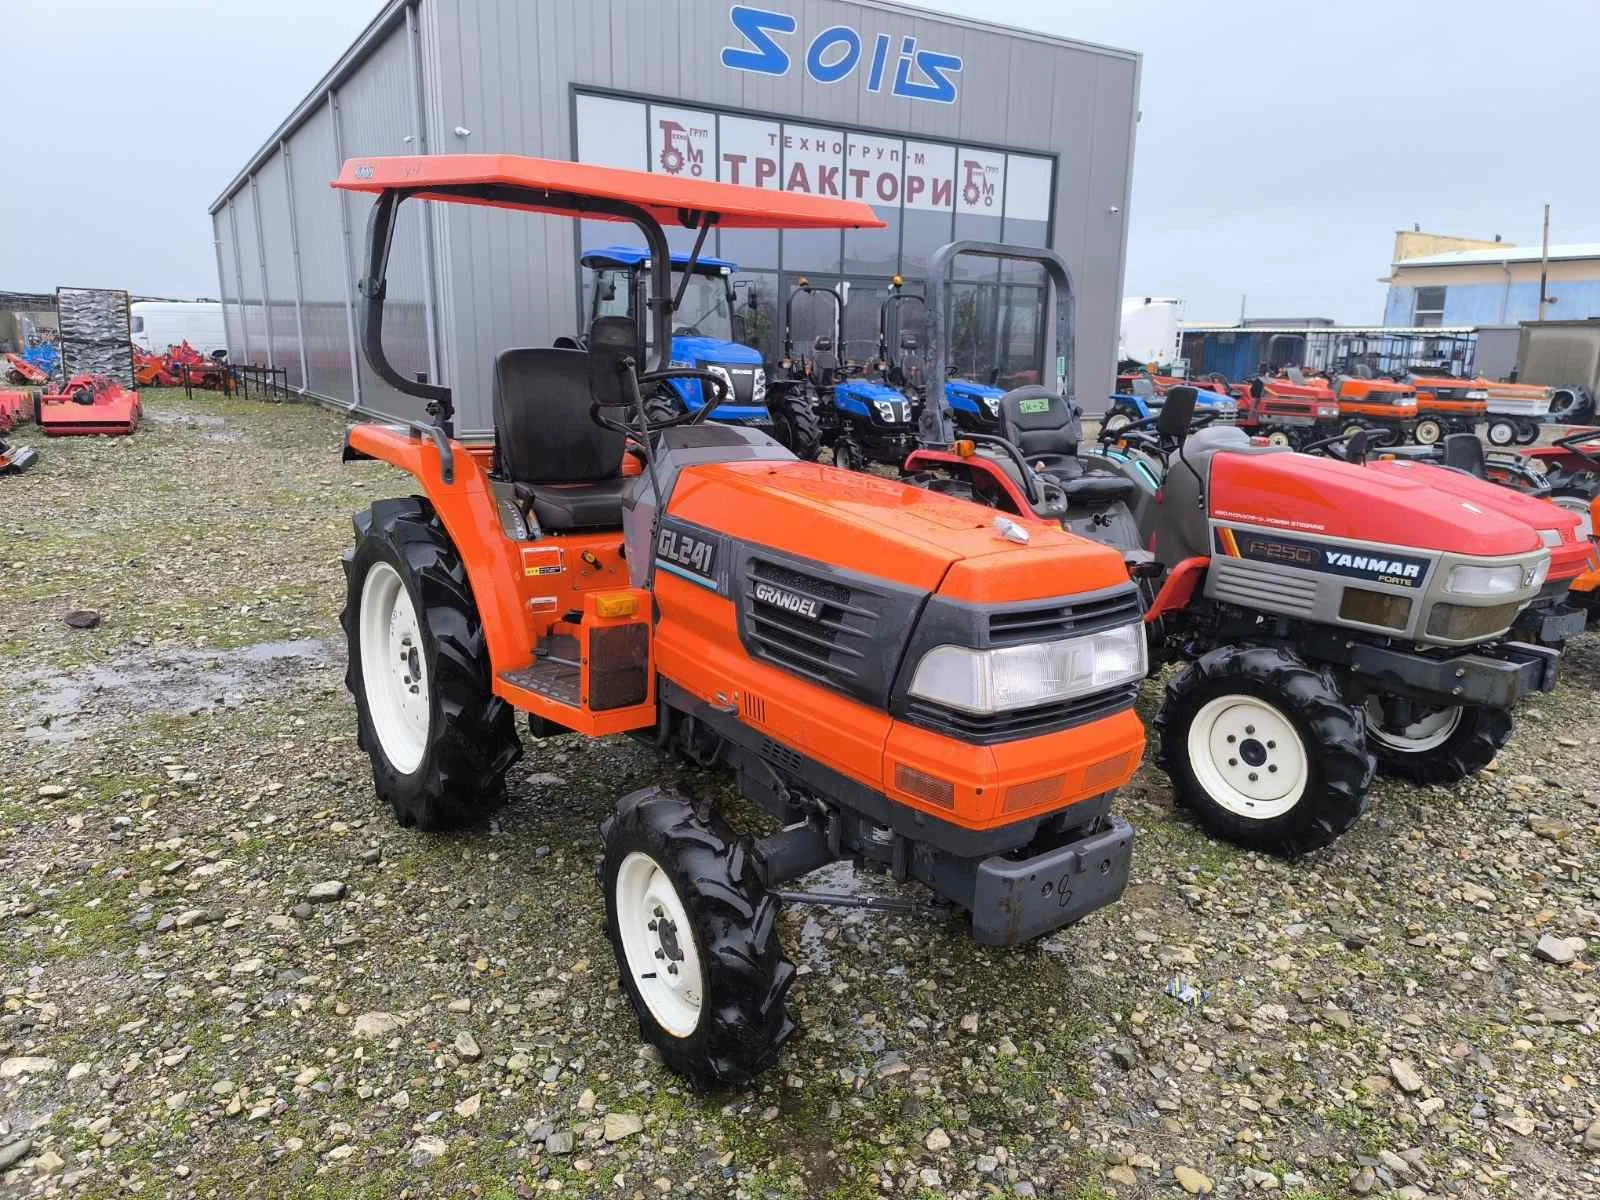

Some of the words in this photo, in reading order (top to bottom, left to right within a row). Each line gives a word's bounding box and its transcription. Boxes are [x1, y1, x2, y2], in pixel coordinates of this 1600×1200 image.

[723, 153, 952, 206] ТРАКТОРИ
[657, 528, 713, 573] GL241
[1325, 551, 1421, 578] YANMAR
[1376, 575, 1412, 586] FORTE
[756, 584, 817, 618] GRANDEL
